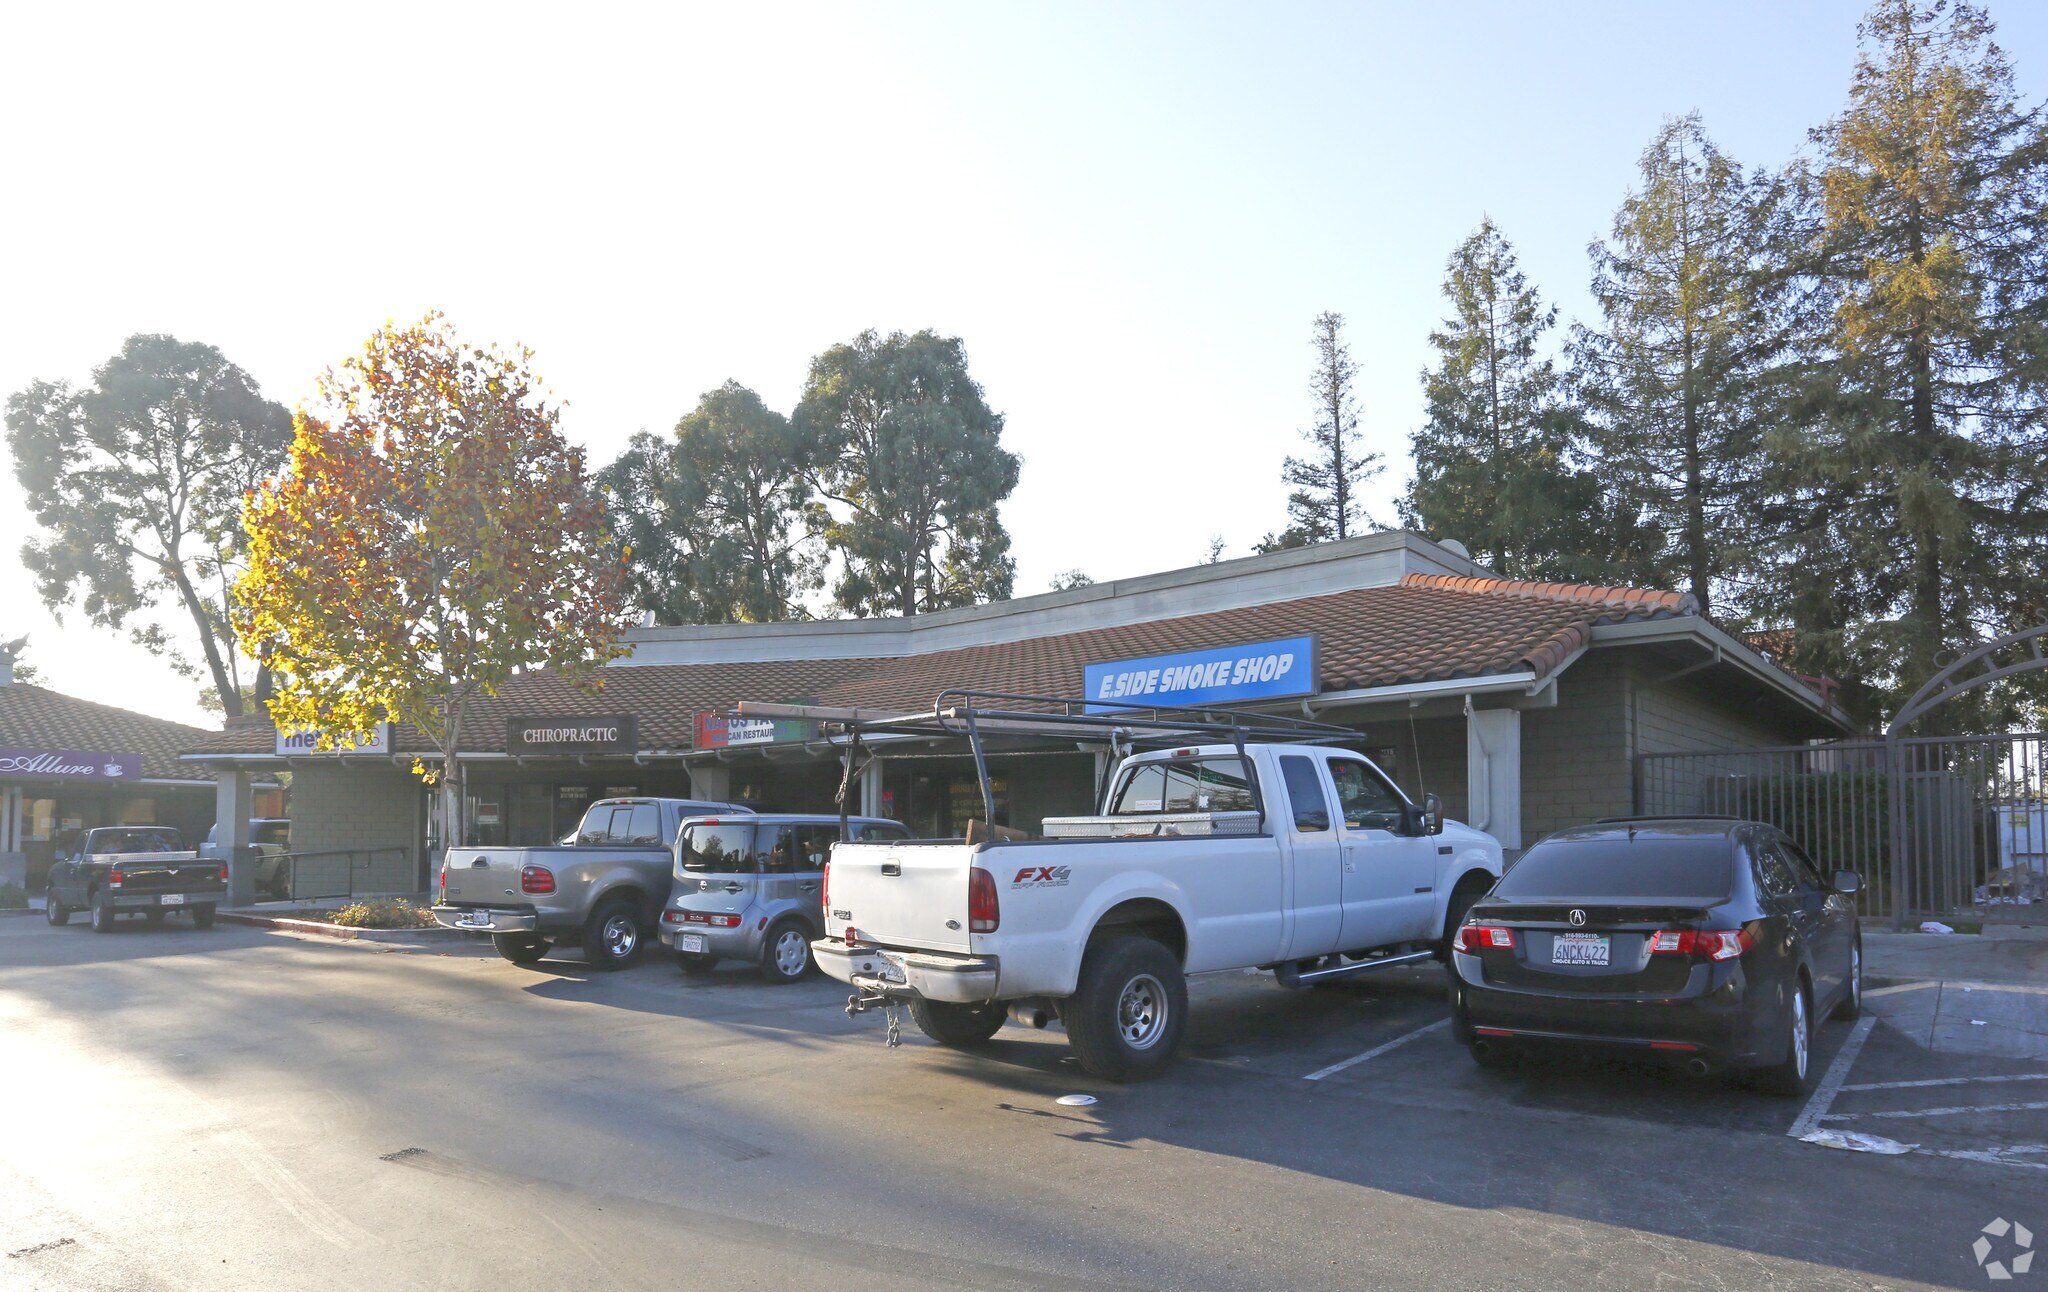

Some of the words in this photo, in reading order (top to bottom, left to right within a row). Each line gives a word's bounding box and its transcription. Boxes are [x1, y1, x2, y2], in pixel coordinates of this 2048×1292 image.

[1098, 669, 1160, 699] E.SIDE
[1159, 661, 1232, 693] SMOKE
[1231, 653, 1294, 685] SHOP
[523, 727, 618, 743] CHIROPRACTIC
[4, 752, 95, 775] Allure
[1012, 865, 1072, 883] FX4
[1555, 944, 1607, 961] 6NCK422
